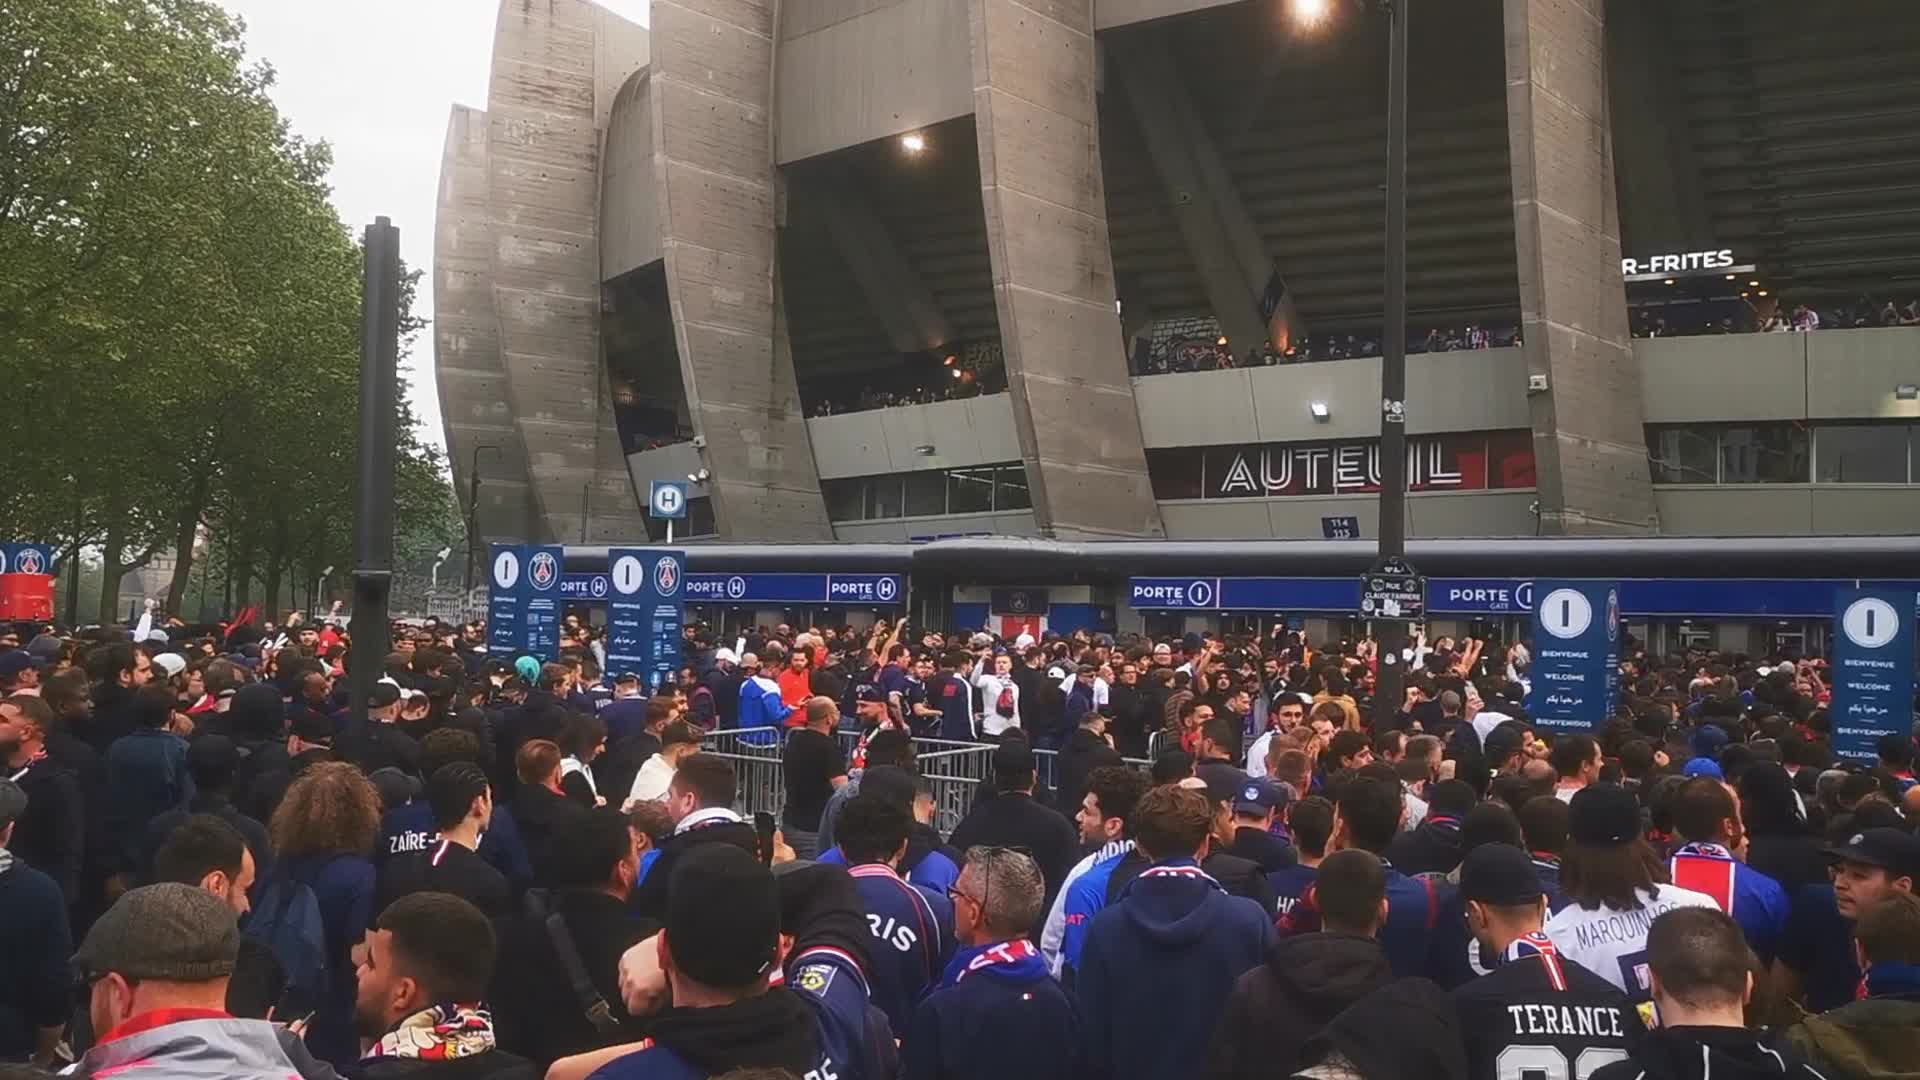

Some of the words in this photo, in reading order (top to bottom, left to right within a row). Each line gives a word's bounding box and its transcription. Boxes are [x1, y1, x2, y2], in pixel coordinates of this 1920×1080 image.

[1622, 249, 1734, 275] R-FRITES
[560, 581, 588, 592] ORTE
[686, 582, 724, 592] PORTE
[831, 583, 873, 594] PORTE
[1134, 586, 1183, 598] PORTE
[1450, 589, 1509, 601] PORTE
[1542, 650, 1590, 659] BIENVENUE
[1844, 659, 1896, 669] BIENVENUE
[1544, 673, 1585, 682] WELCOME
[1847, 682, 1892, 692] WELCOME
[1536, 717, 1592, 729] BIENVENIDOS
[1837, 727, 1898, 736] BIENVENID
[1507, 1004, 1624, 1037] TERANCE
